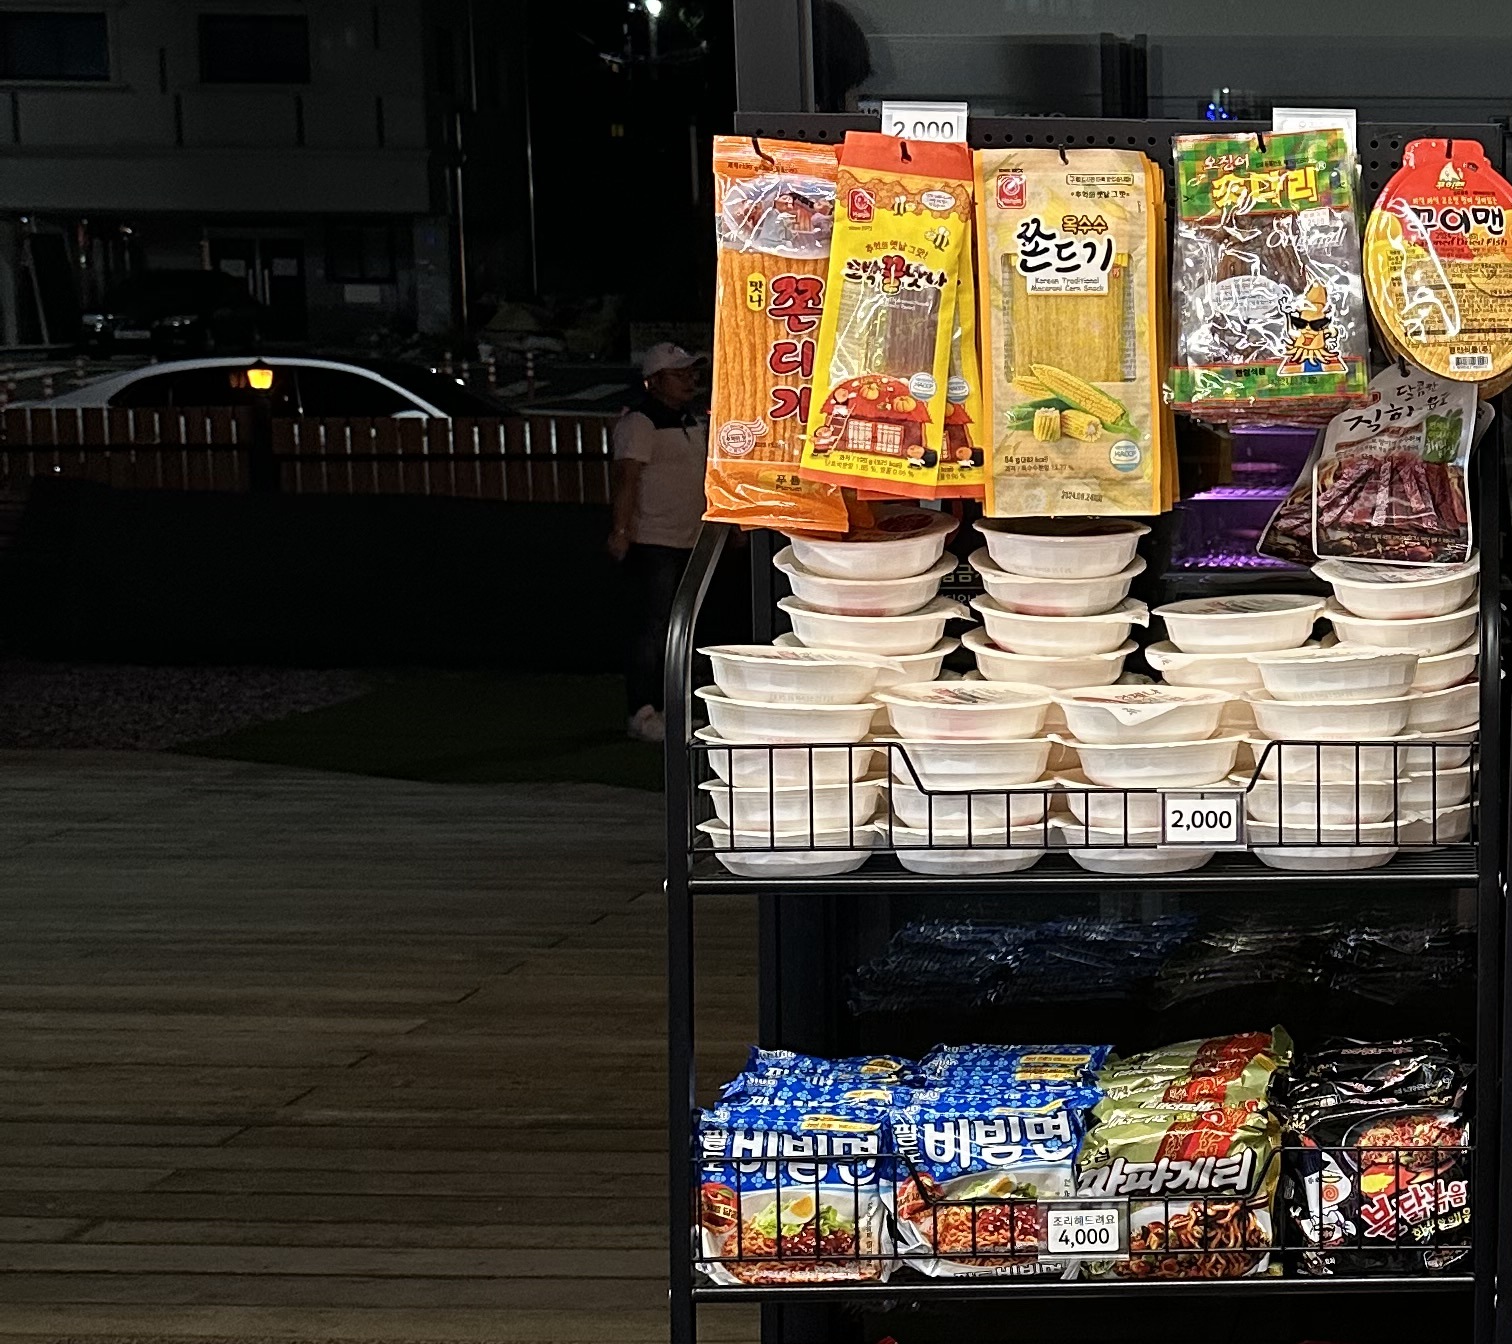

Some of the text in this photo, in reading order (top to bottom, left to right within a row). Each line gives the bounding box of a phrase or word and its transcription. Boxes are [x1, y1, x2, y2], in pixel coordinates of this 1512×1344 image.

[892, 121, 954, 140] 2,000
[1204, 154, 1249, 171] 오징어
[1062, 215, 1108, 234] 옥수수
[1017, 217, 1112, 272] 쫀드기
[1487, 237, 1508, 247] Fish
[748, 280, 764, 308] 맛나
[1171, 810, 1232, 830] 2,000
[924, 1110, 1073, 1168] 비빔면
[732, 1130, 878, 1185] 비빔면
[1053, 1214, 1116, 1227] 조리해드려요
[1058, 1228, 1110, 1247] 4,000
